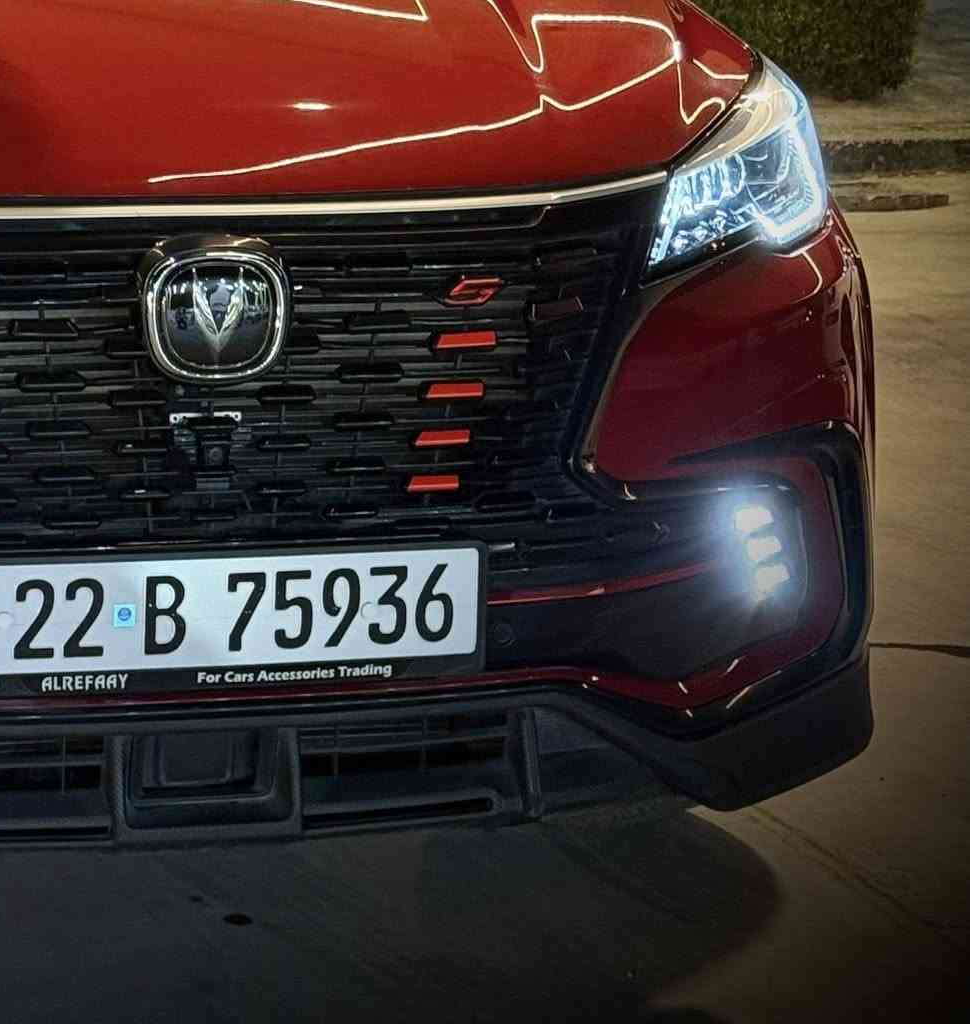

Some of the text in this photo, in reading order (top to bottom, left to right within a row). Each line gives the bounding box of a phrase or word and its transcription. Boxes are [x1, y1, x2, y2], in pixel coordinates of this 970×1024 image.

[13, 563, 454, 660] 22 B 75936
[41, 673, 129, 693] ALREFAAY
[197, 664, 392, 684] For Cars Accessories Trading
